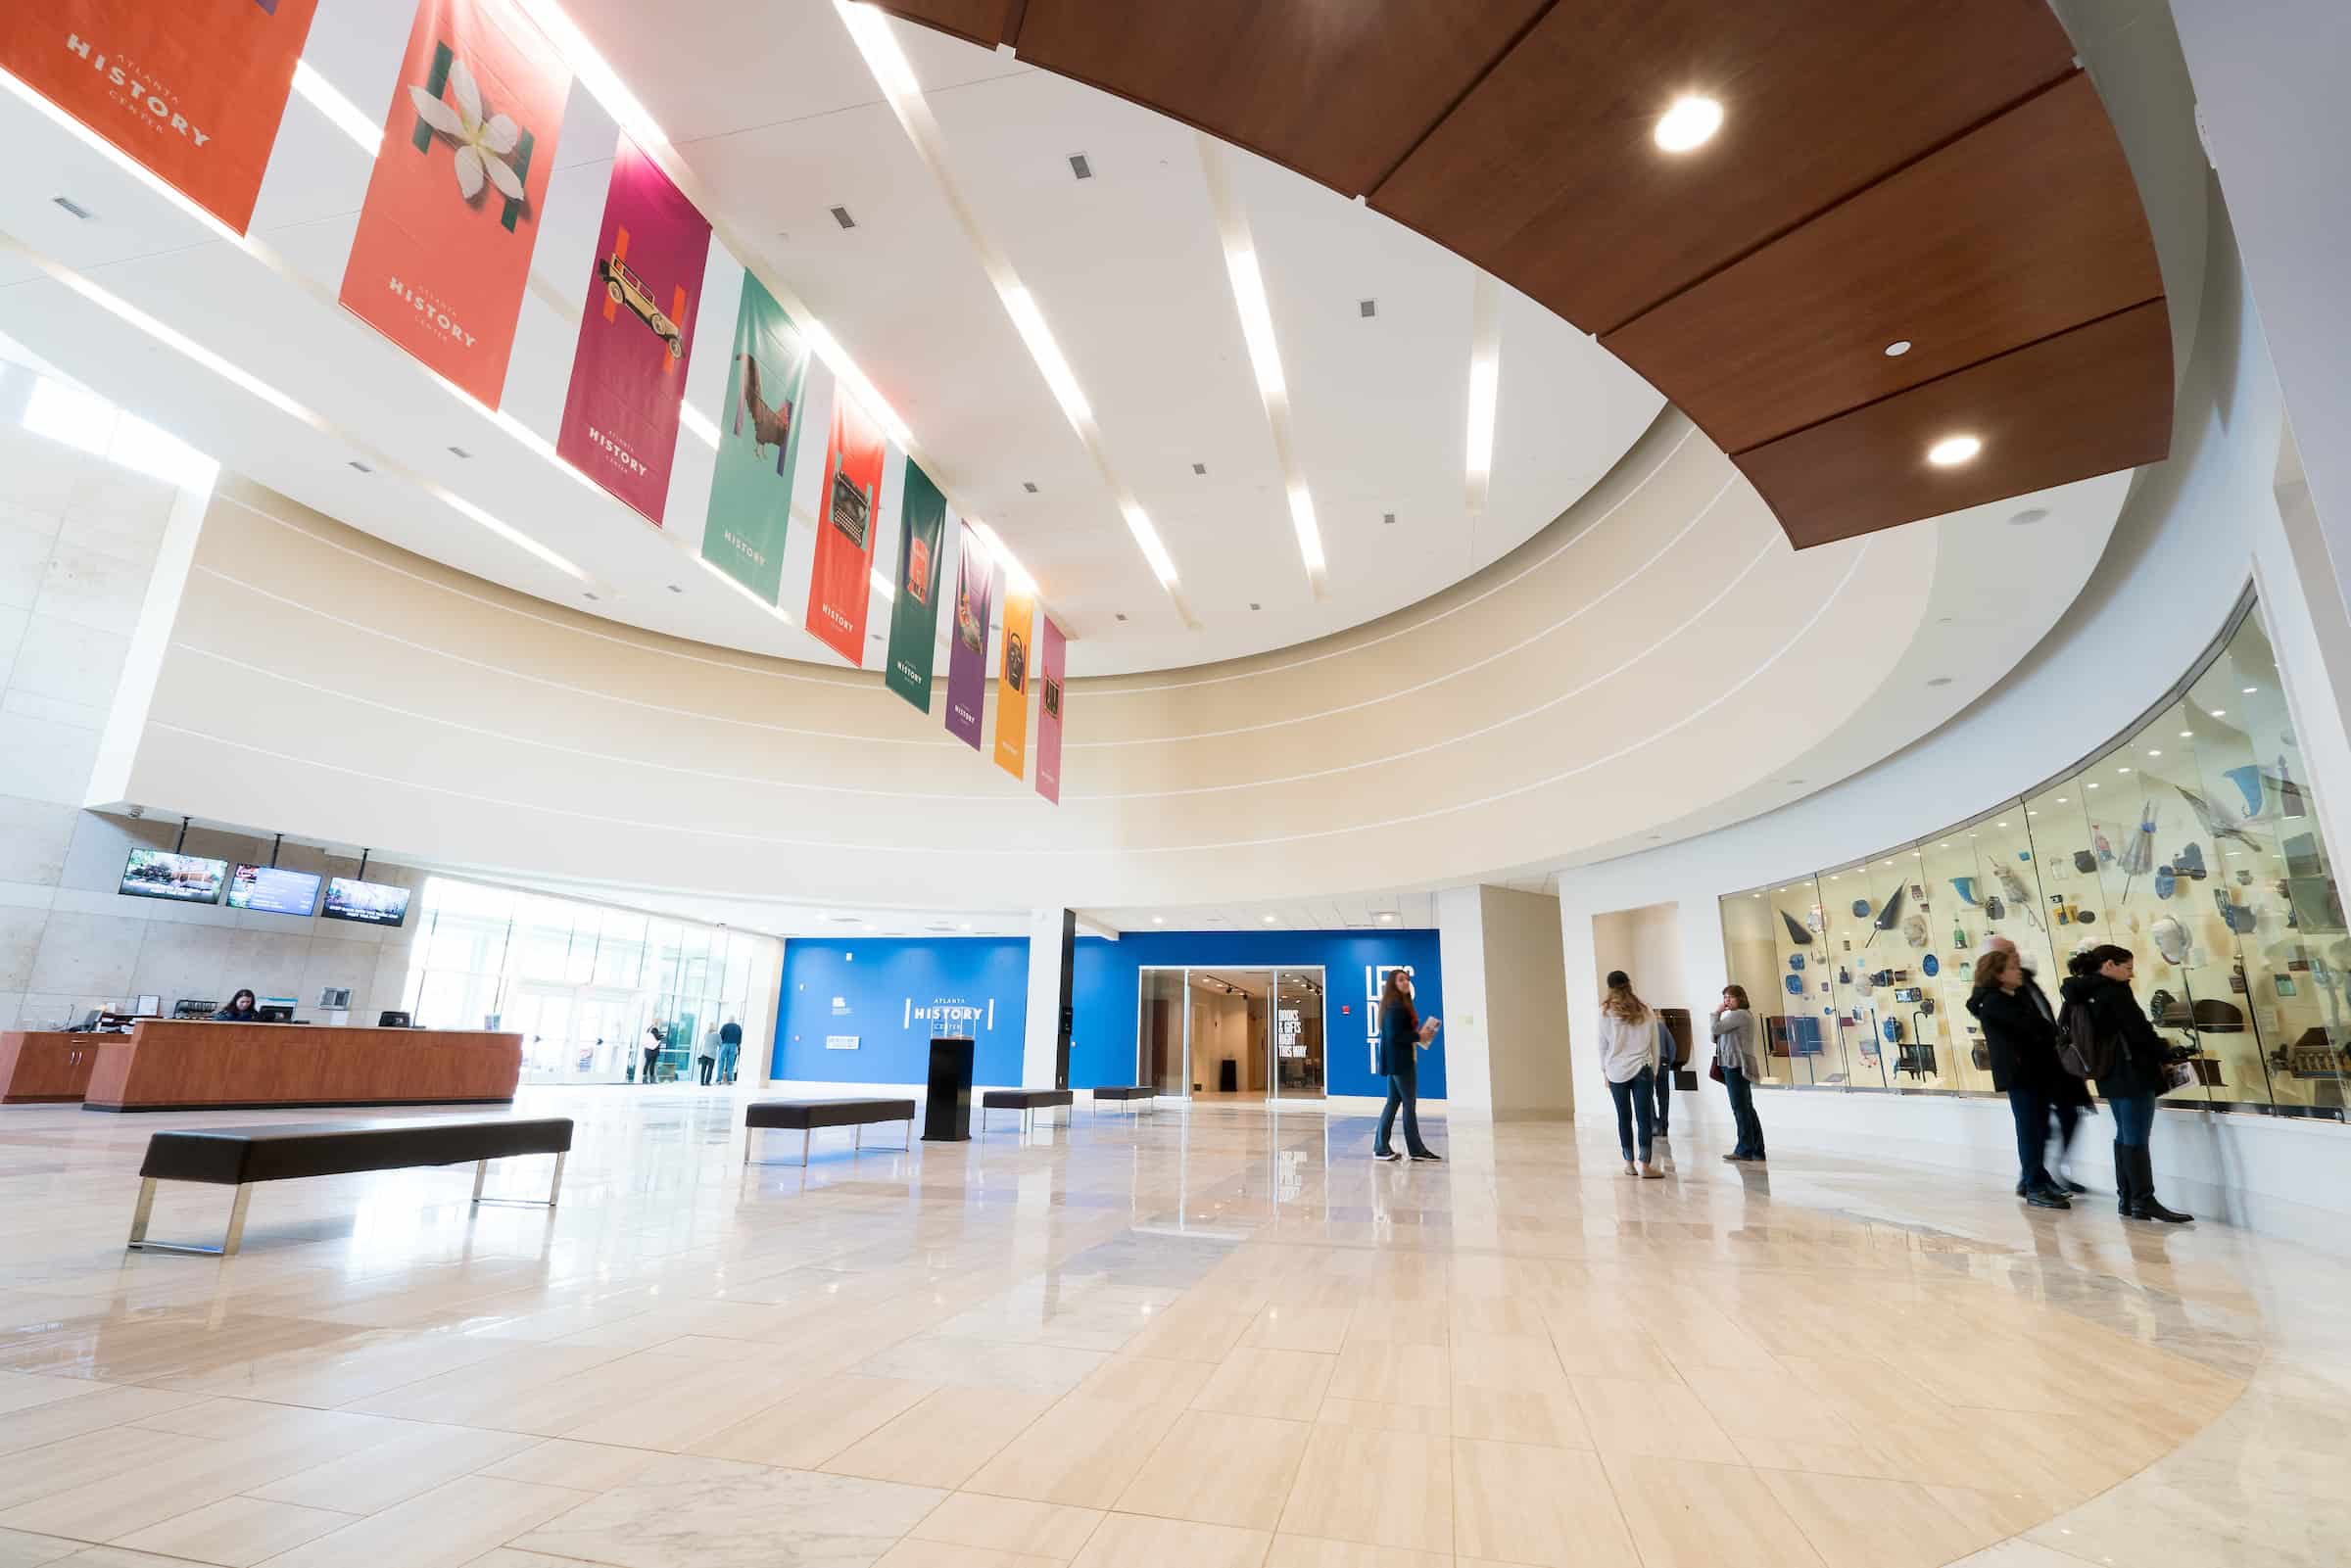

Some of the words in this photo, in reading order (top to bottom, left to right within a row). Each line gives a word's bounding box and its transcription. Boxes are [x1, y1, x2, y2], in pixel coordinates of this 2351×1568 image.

[67, 32, 212, 147] HISTORY
[388, 275, 477, 348] HISTORY
[589, 427, 648, 476] HISTORY
[723, 531, 768, 566] HISTORY
[822, 602, 854, 633] HISTORY
[914, 1007, 984, 1021] HISTORY
